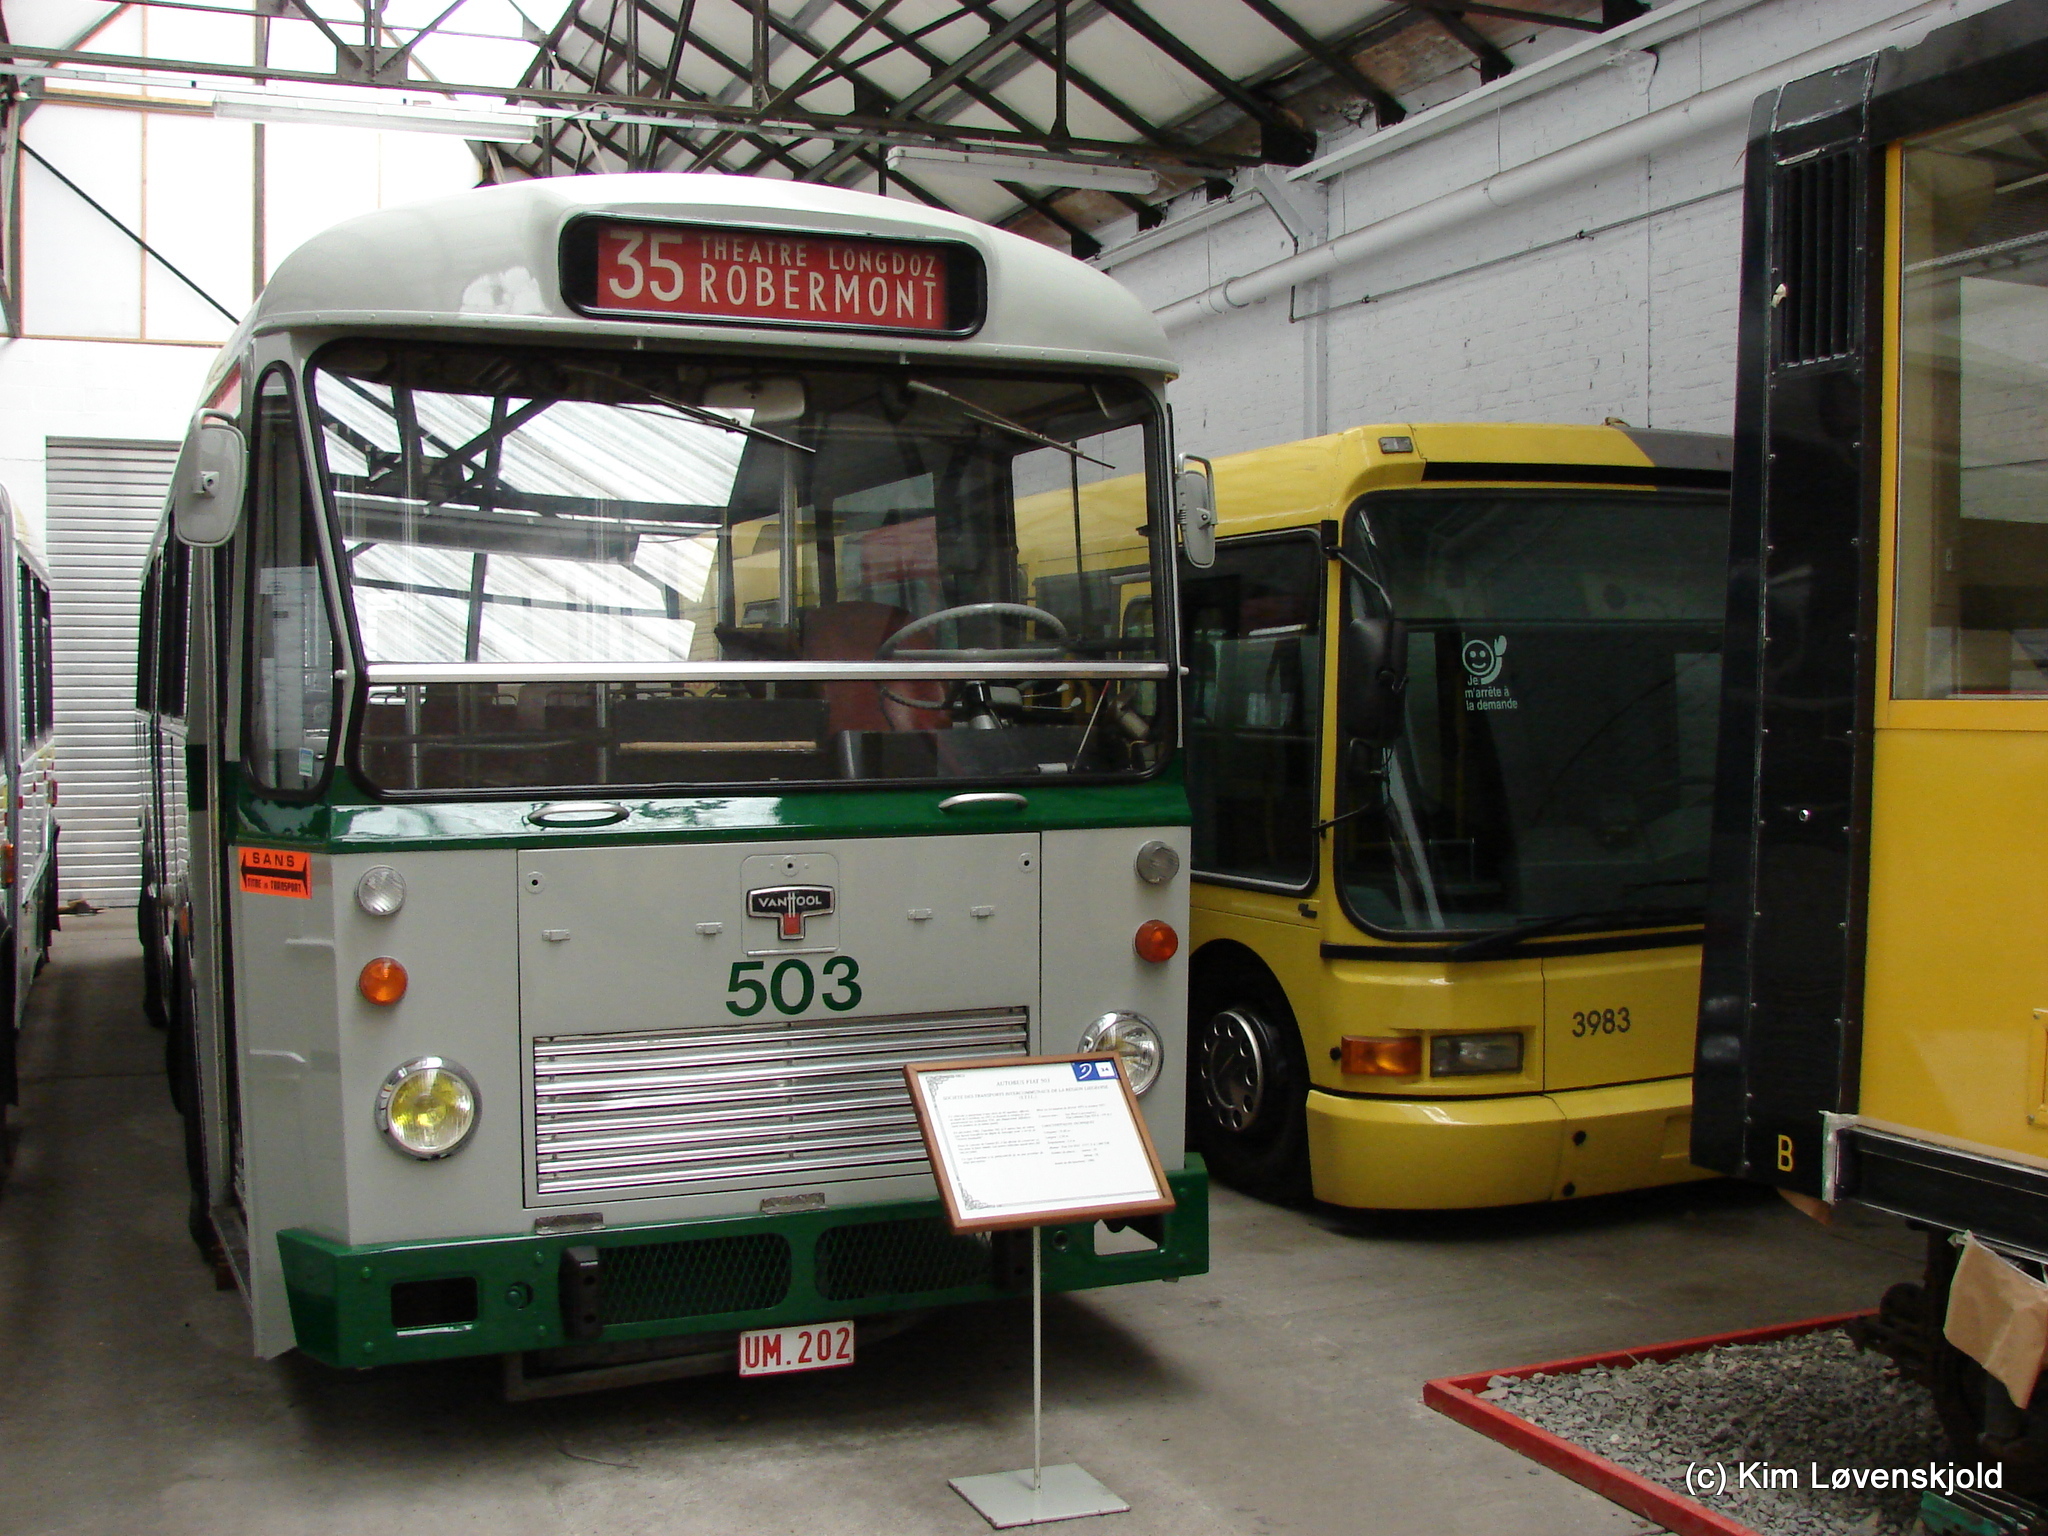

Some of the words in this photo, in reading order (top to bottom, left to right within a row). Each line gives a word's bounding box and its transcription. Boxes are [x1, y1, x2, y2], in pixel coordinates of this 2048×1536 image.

[608, 230, 684, 302] 35
[701, 236, 807, 267] THEATRE
[828, 247, 936, 278] LONGDOZ
[701, 263, 938, 320] ROBERMONT
[1467, 675, 1478, 686] Je
[1466, 700, 1475, 711] la
[1477, 698, 1518, 711] demande
[252, 852, 295, 867] SANS
[725, 955, 862, 1017] 503
[1572, 1006, 1631, 1038] 3983
[1778, 1134, 1793, 1172] B
[745, 1327, 850, 1368] UM.202
